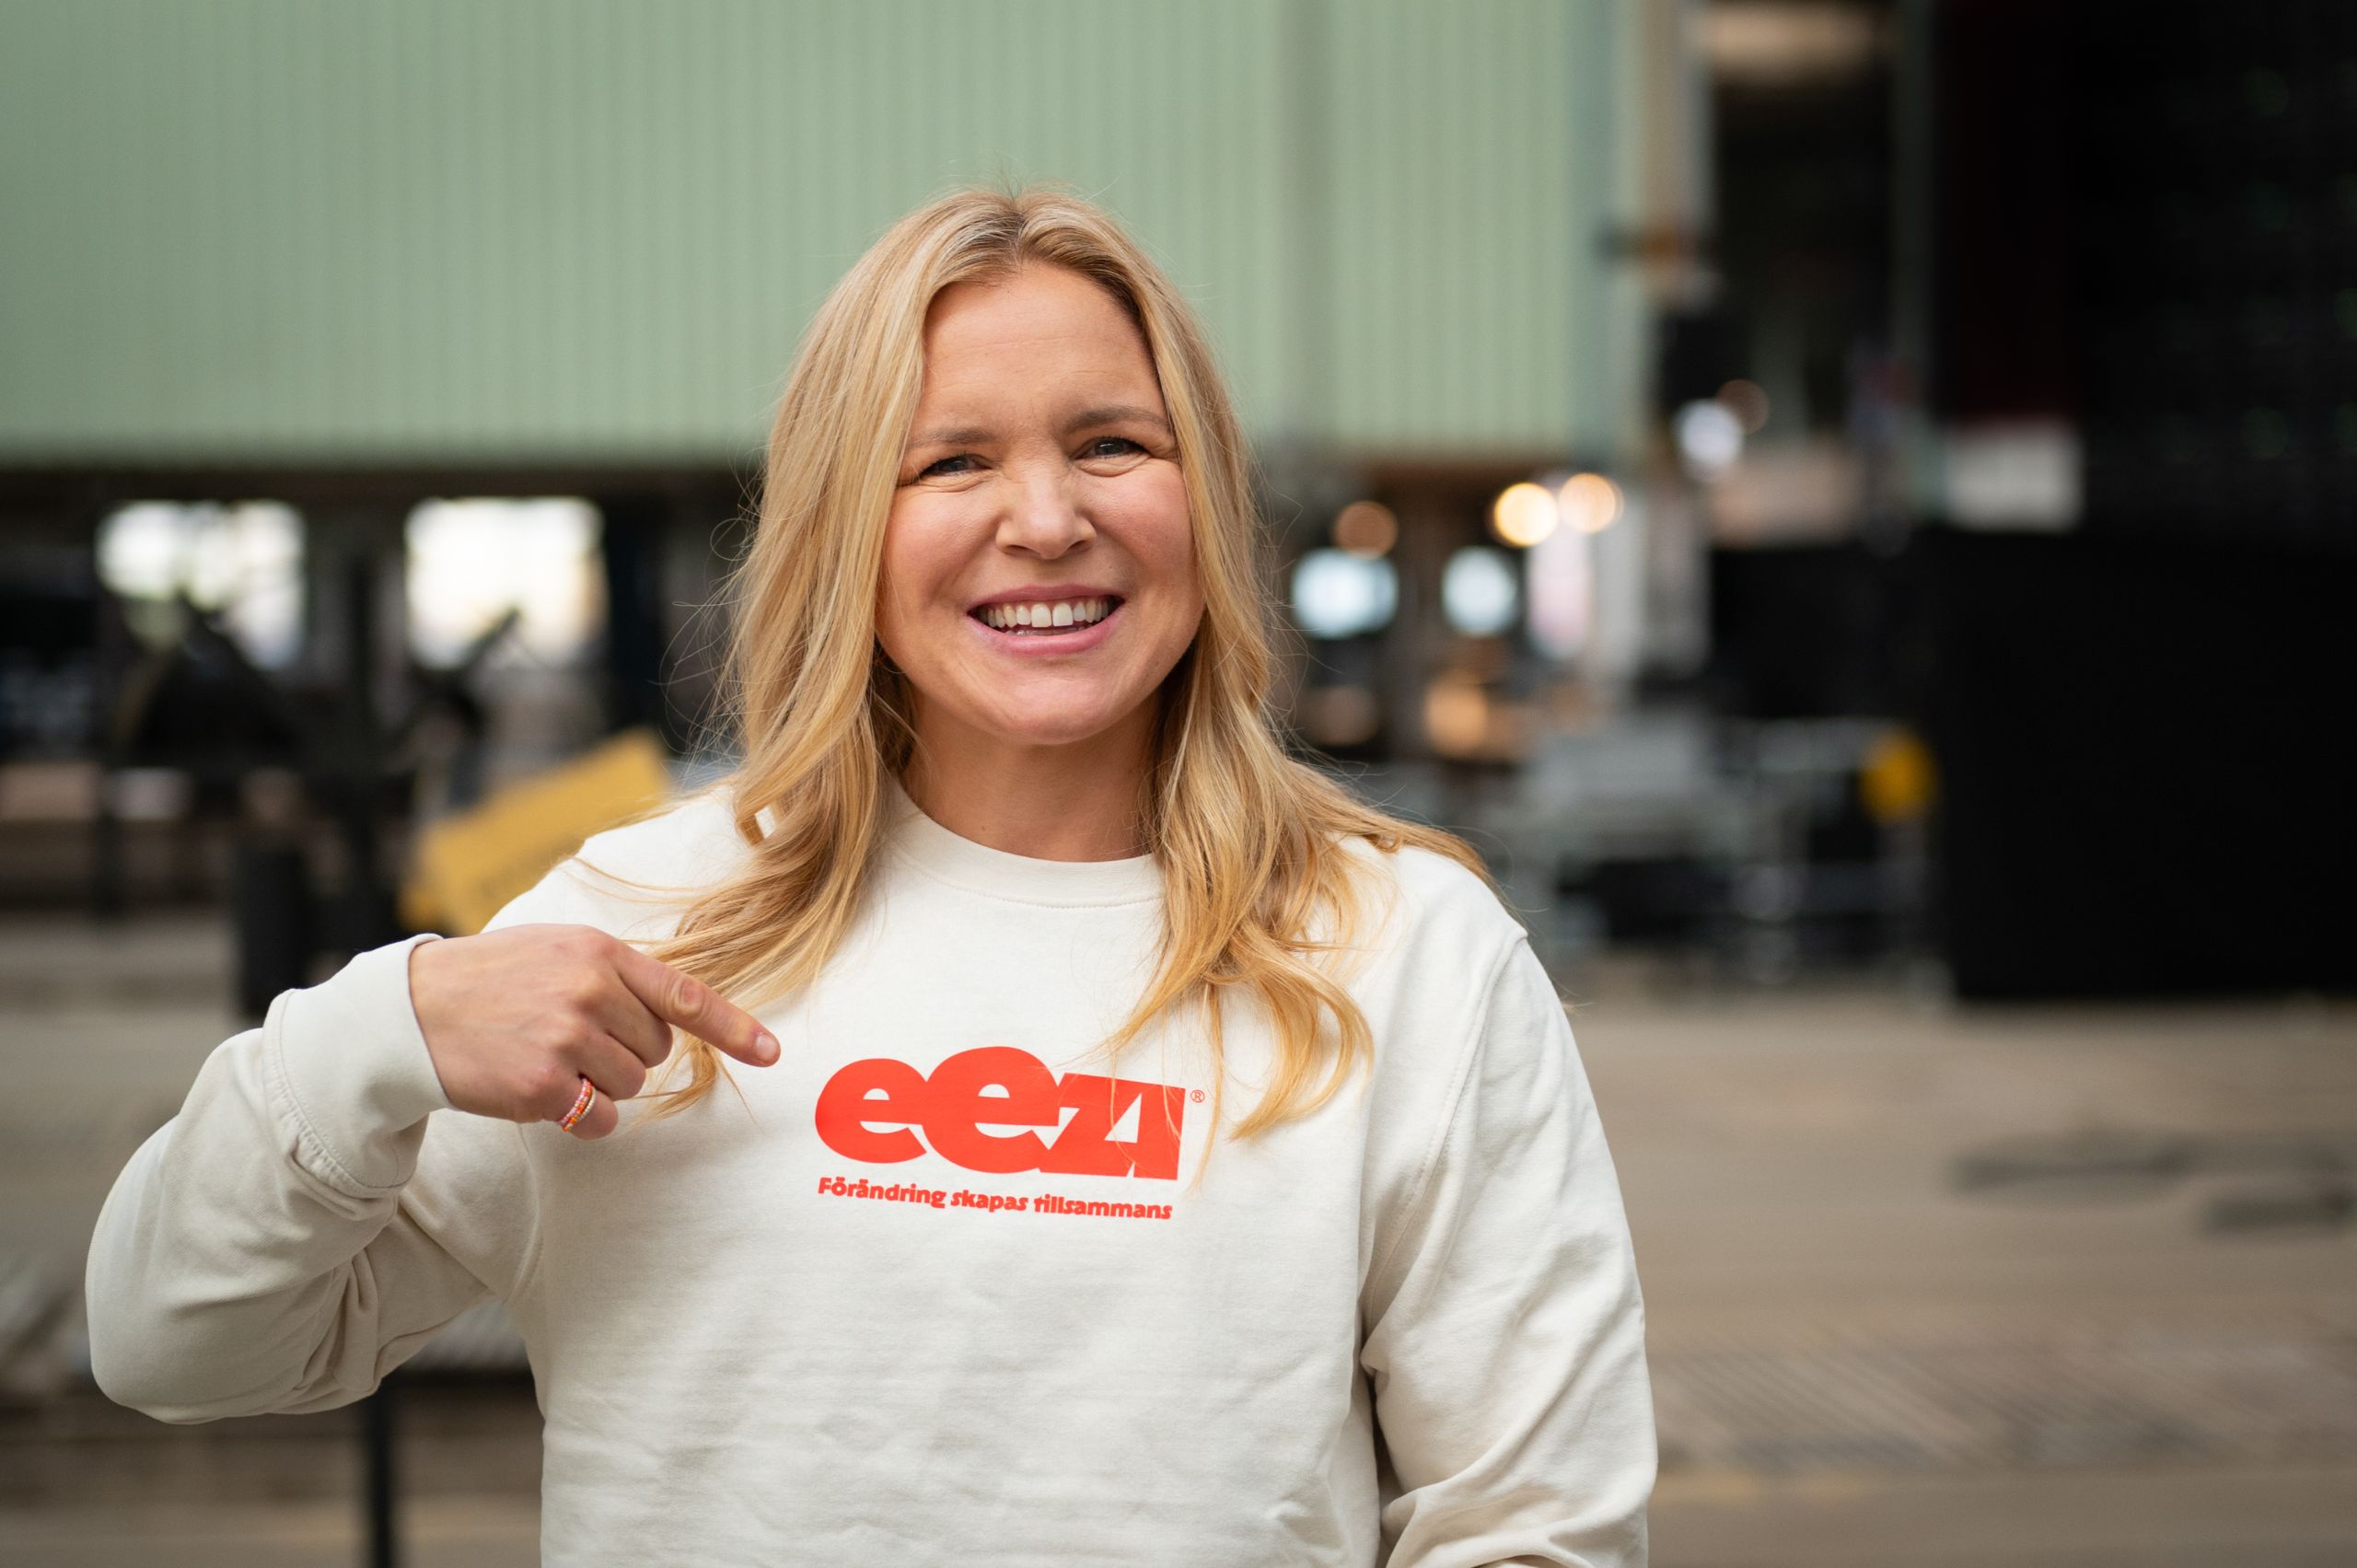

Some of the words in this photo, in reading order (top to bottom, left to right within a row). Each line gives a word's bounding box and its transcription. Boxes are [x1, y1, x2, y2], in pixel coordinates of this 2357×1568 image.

[817, 1176, 947, 1209] Förändring
[949, 1189, 1029, 1214] skapas
[1033, 1193, 1173, 1220] tillsammans
